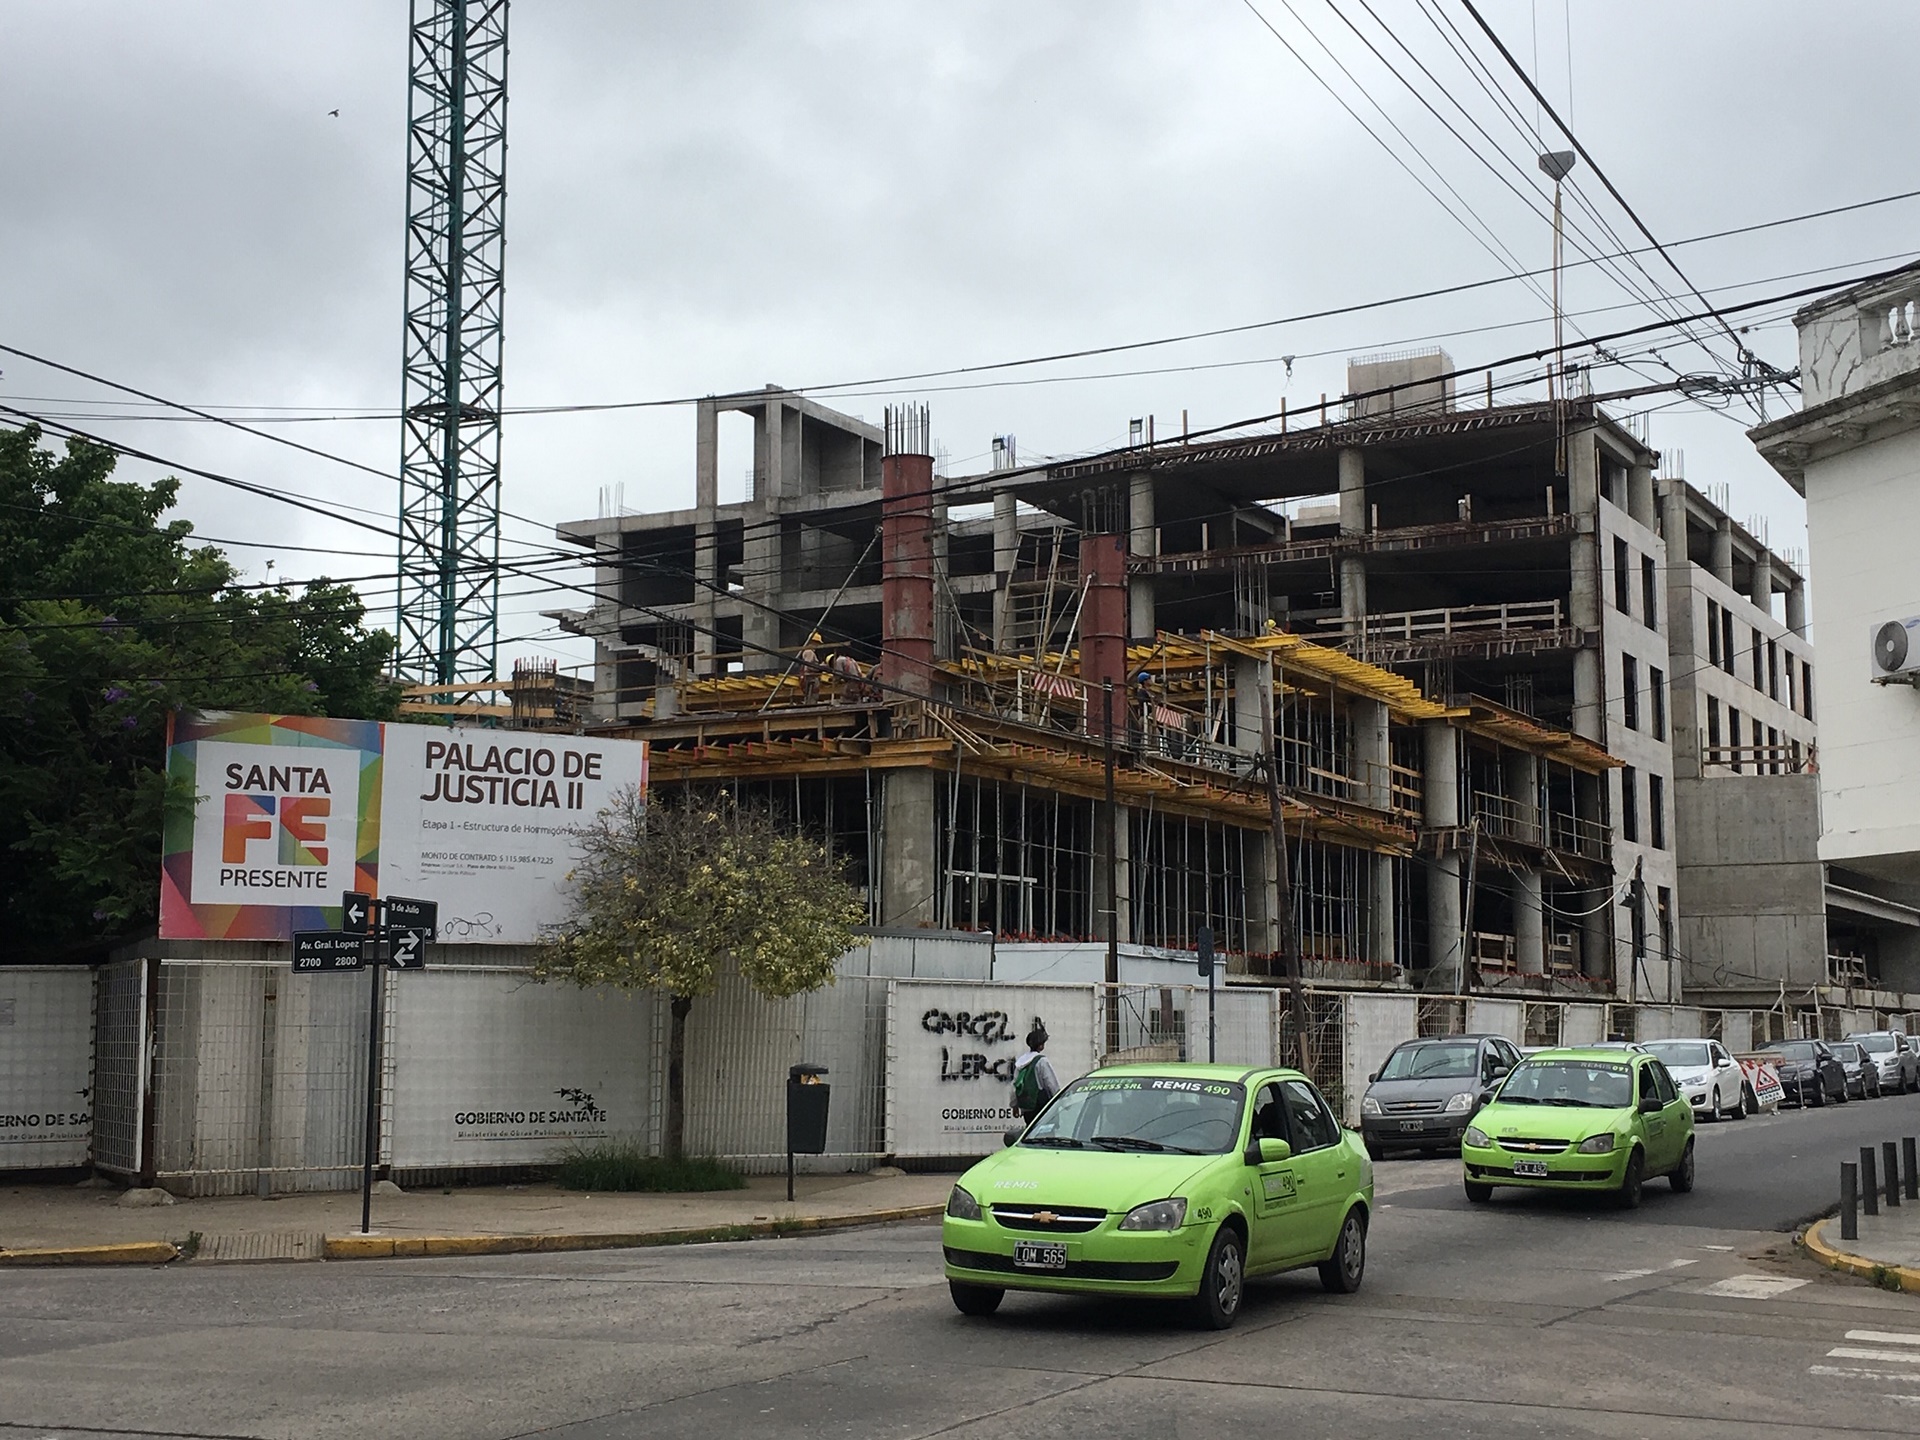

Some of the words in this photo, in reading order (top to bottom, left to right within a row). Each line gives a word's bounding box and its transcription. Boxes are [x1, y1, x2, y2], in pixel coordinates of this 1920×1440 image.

[426, 741, 555, 776] PALACIO
[563, 751, 602, 780] DE
[225, 763, 331, 794] SANTA
[421, 773, 560, 808] JUSTICIA
[567, 782, 583, 810] II
[222, 793, 330, 866] FE
[422, 820, 447, 830] Etapa
[463, 821, 509, 832] Estructura
[511, 824, 521, 833] de
[421, 852, 448, 861] MONTO
[449, 853, 458, 861] DE
[220, 868, 327, 889] PRESENTE
[391, 903, 396, 911] 9
[396, 904, 404, 912] de
[405, 905, 420, 914] Julio
[301, 941, 312, 950] Av.
[314, 940, 333, 950] Gral.
[335, 940, 360, 950] Lopez
[300, 958, 321, 967] 2700
[335, 957, 357, 966] 2800
[1076, 1083, 1121, 1092] EXPRESS
[1152, 1081, 1201, 1092] REMIS
[1204, 1085, 1231, 1096] 490
[45, 1113, 65, 1126] DE
[455, 1112, 525, 1125] GOBIERNO
[529, 1111, 546, 1123] DE
[549, 1111, 590, 1123] SANTA
[594, 1110, 607, 1122] FE
[942, 1108, 996, 1120] GOBIERNO
[999, 1109, 1012, 1119] DE
[994, 1181, 1038, 1190] REMIS
[1197, 1206, 1213, 1220] 490
[1042, 1249, 1064, 1265] 565
